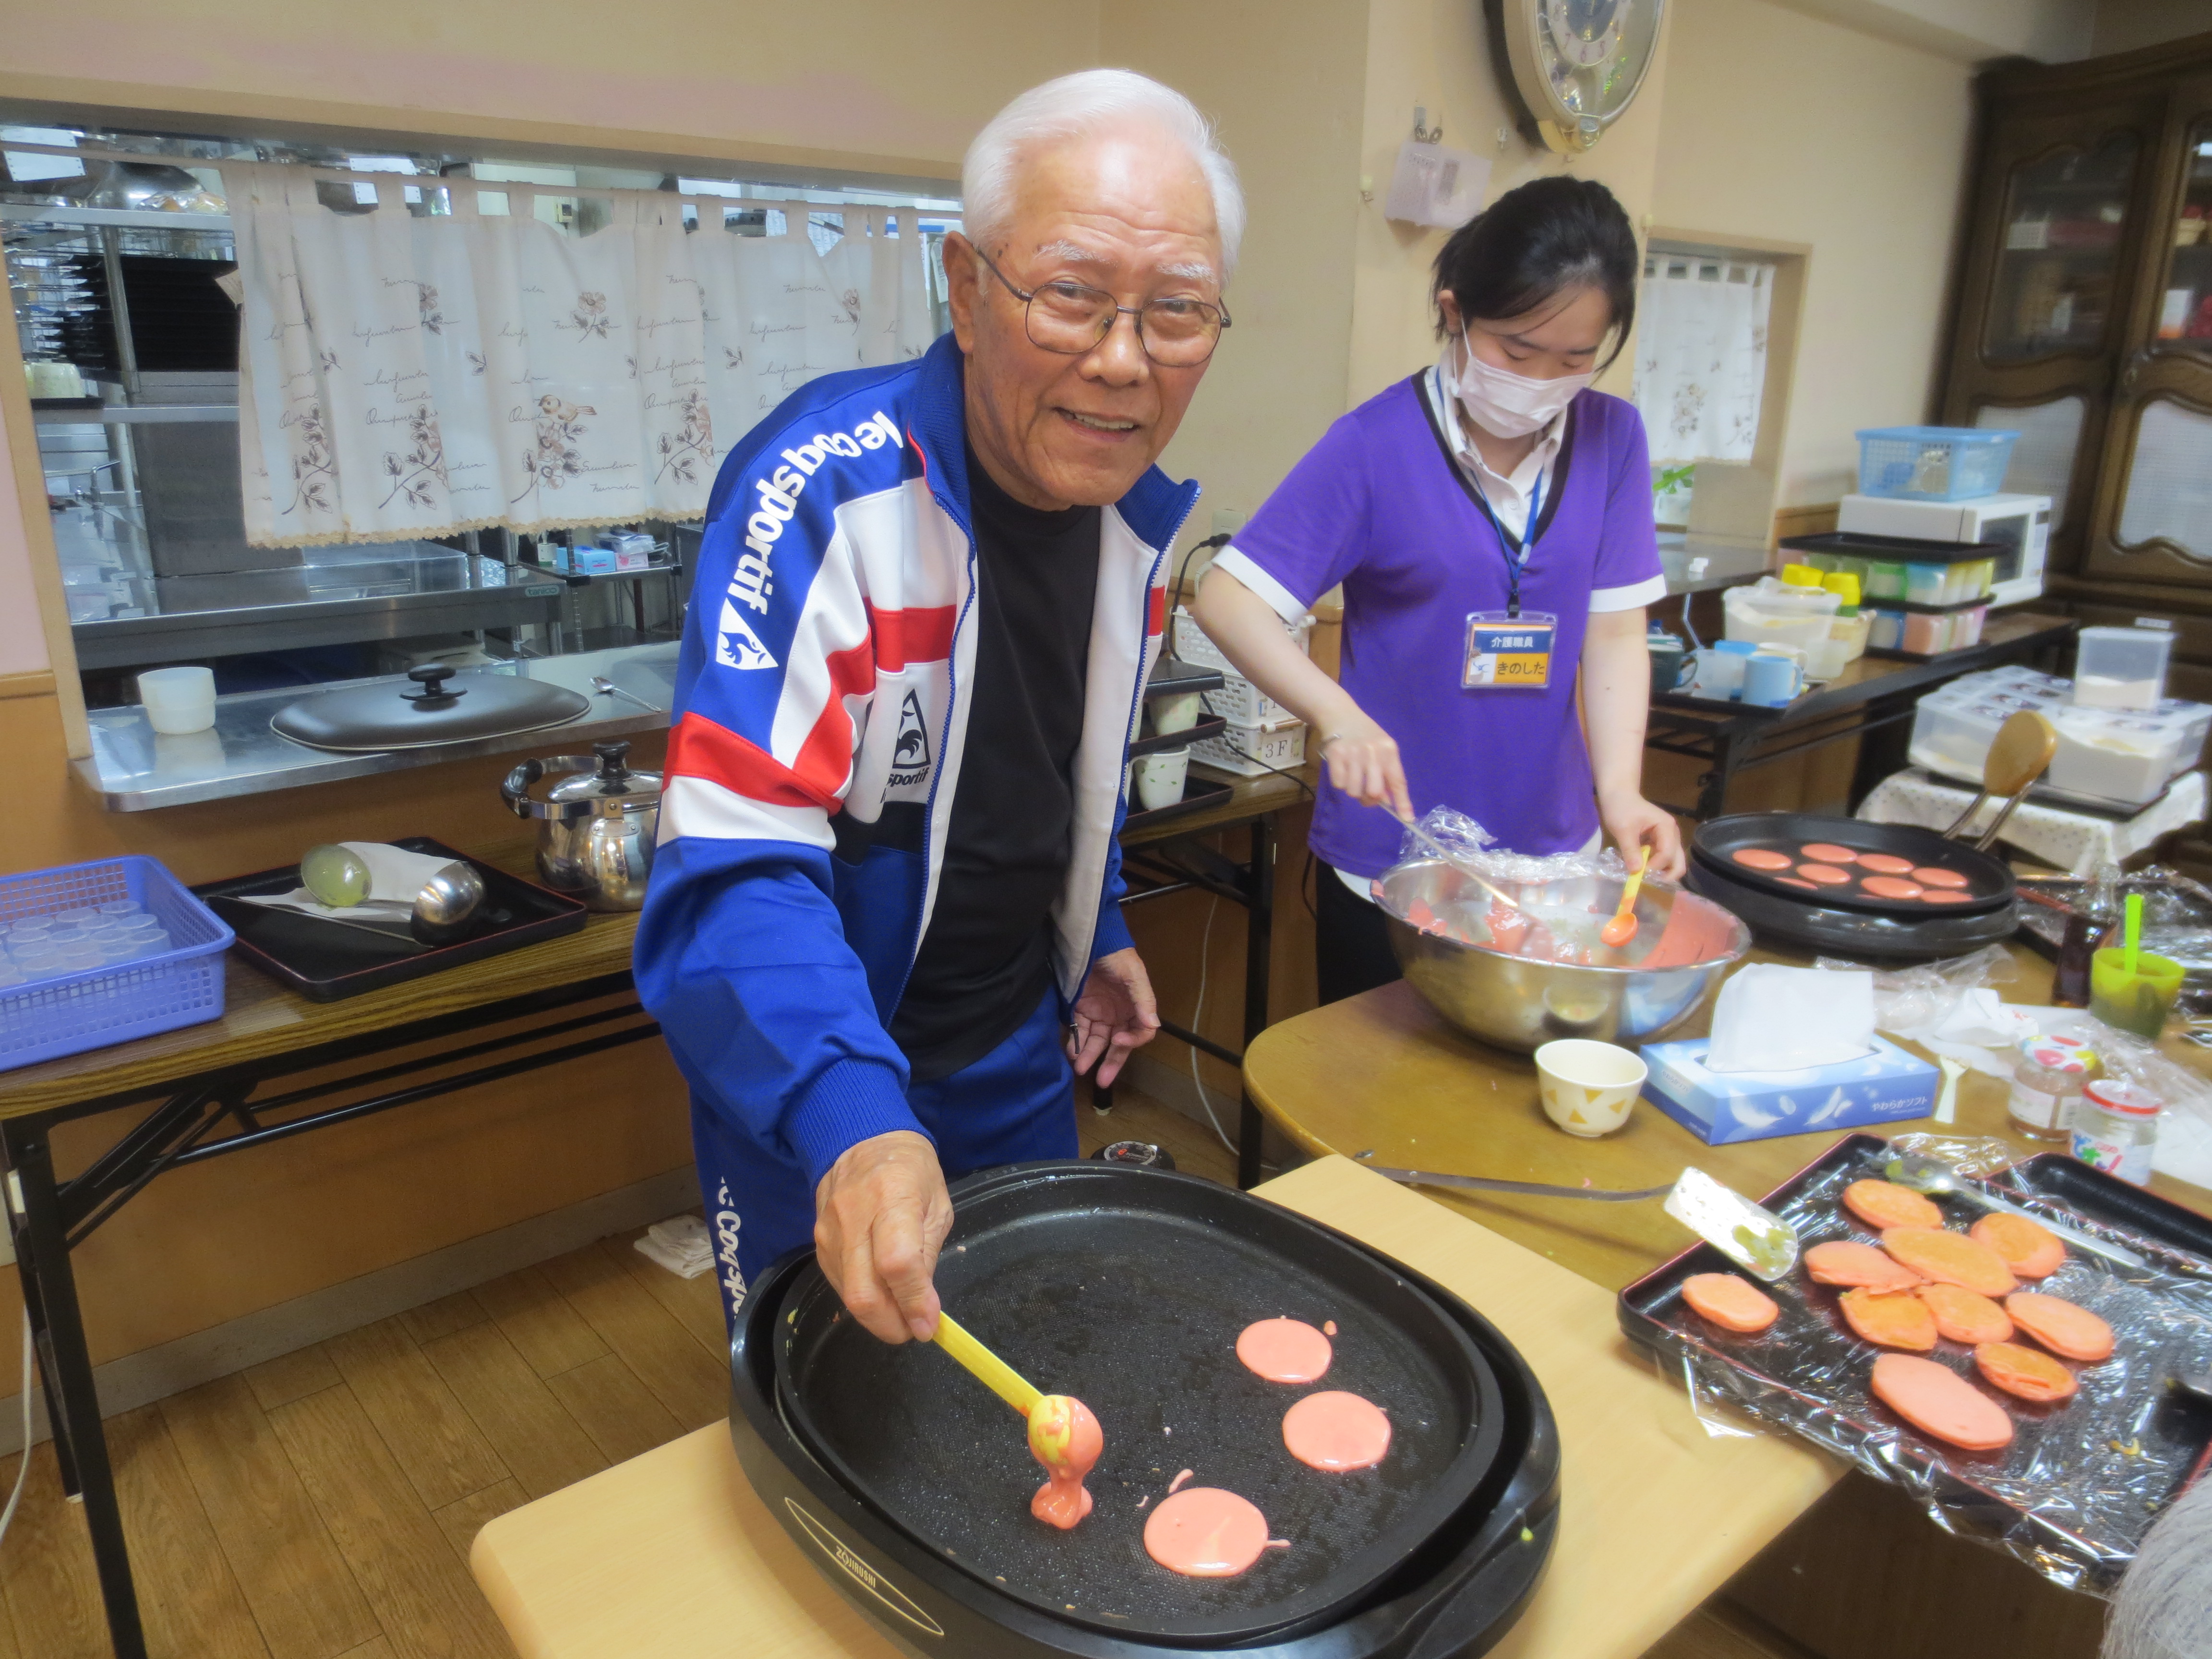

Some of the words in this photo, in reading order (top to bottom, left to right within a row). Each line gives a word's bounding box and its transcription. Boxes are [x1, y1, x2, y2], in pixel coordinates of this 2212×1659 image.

[854, 410, 903, 450] le
[1491, 636, 1533, 648] 介護職員
[1497, 661, 1545, 675] きのした
[836, 1545, 876, 1588] ZOJIRUSHI
